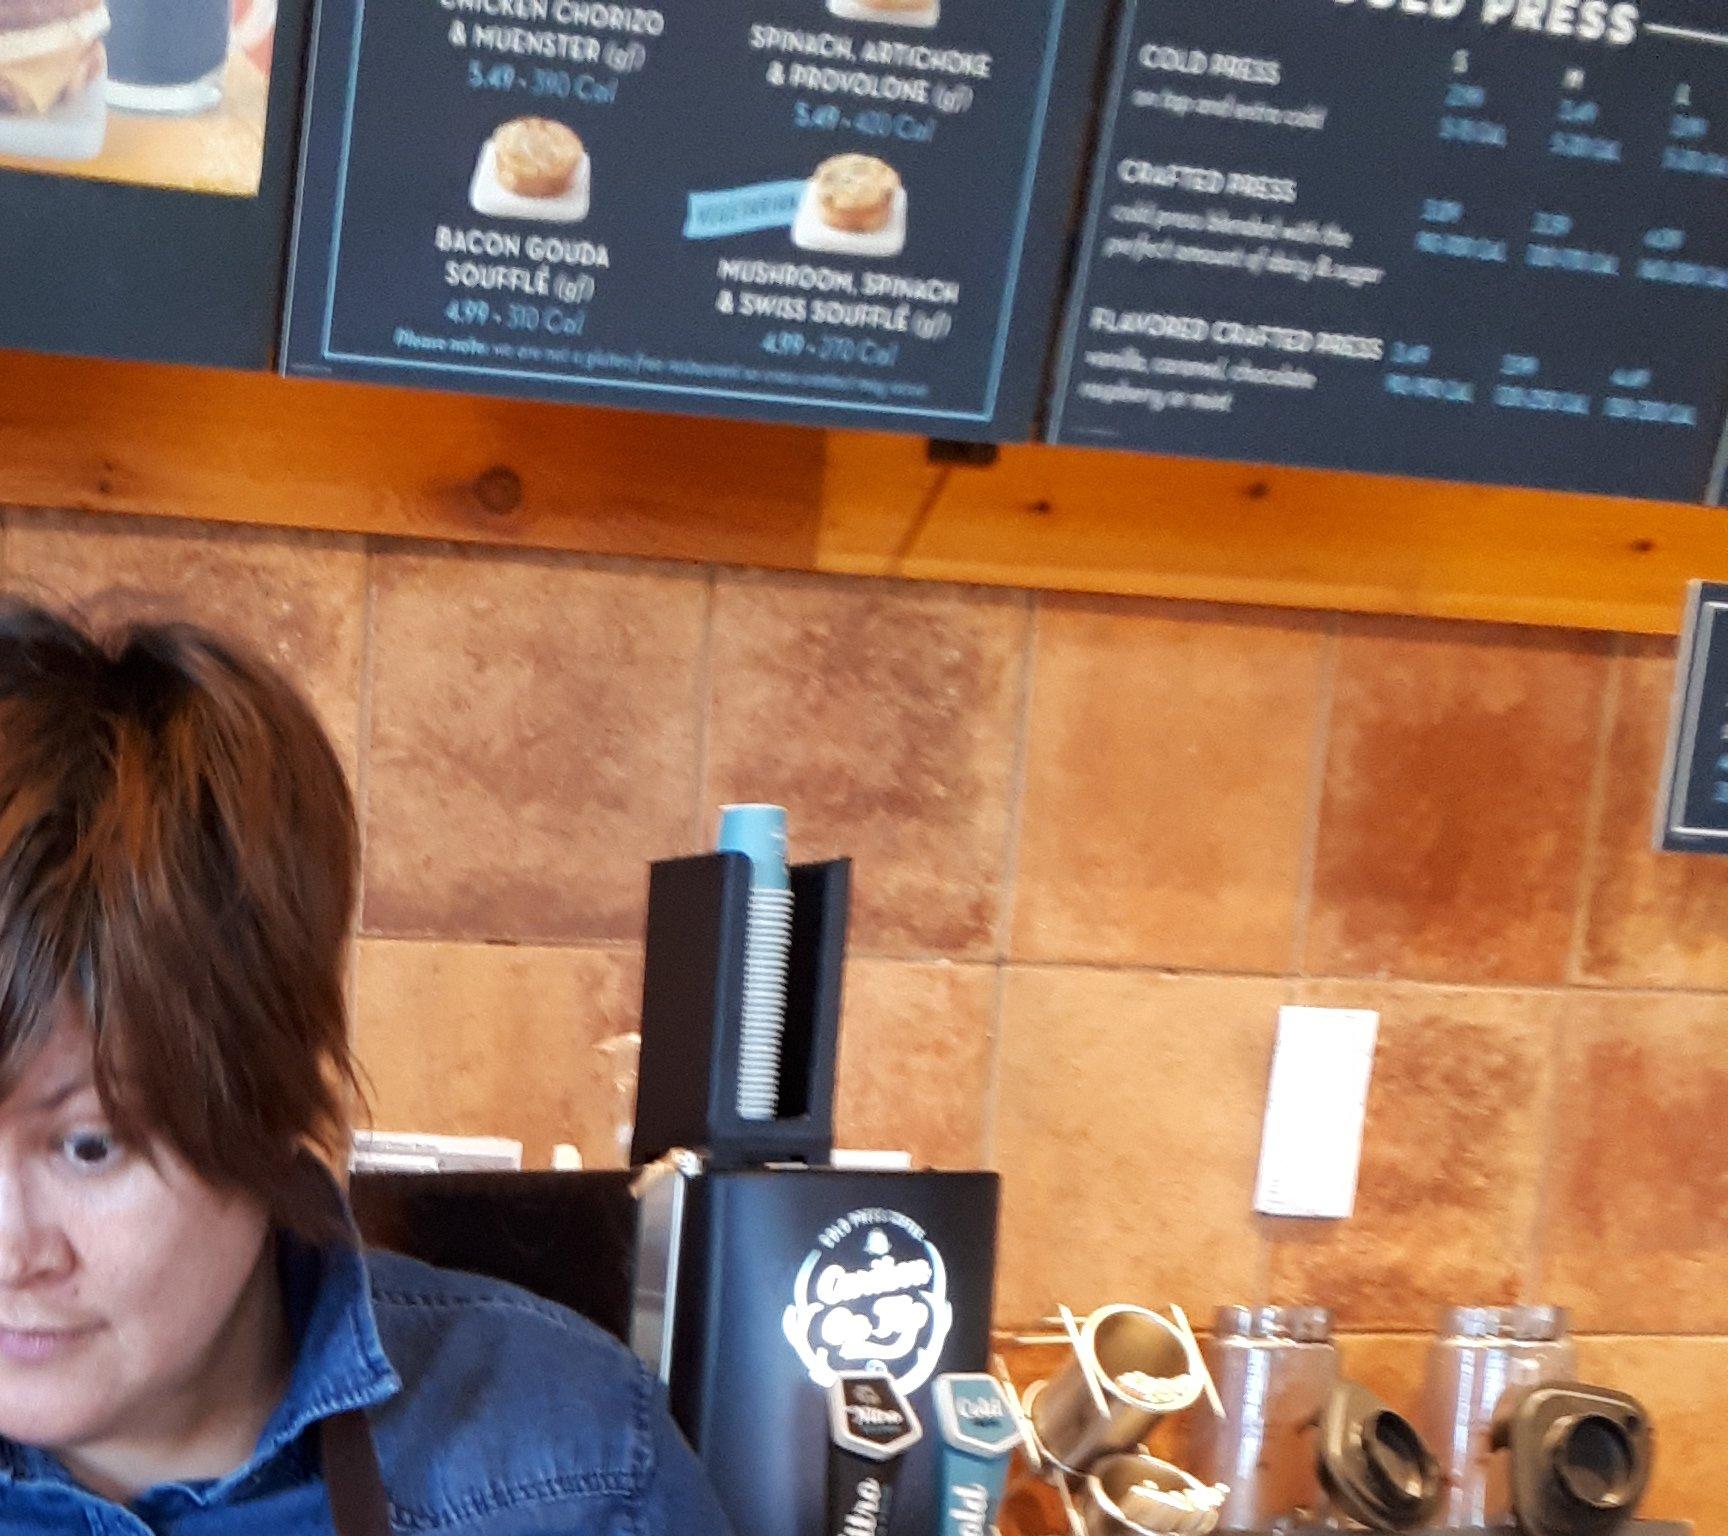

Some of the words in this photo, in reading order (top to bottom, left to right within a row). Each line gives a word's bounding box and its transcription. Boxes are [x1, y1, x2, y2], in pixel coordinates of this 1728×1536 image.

[551, 2, 665, 37] CHORIZO
[473, 23, 602, 63] MUENSTER
[788, 62, 930, 104] PROVOLONE
[1139, 43, 1208, 76] COLD
[1208, 52, 1282, 86] PRESS
[434, 224, 521, 259] BACON
[524, 235, 610, 269] GOUDA
[444, 259, 551, 297] SOUFFLÉ
[737, 291, 807, 323] SWISS
